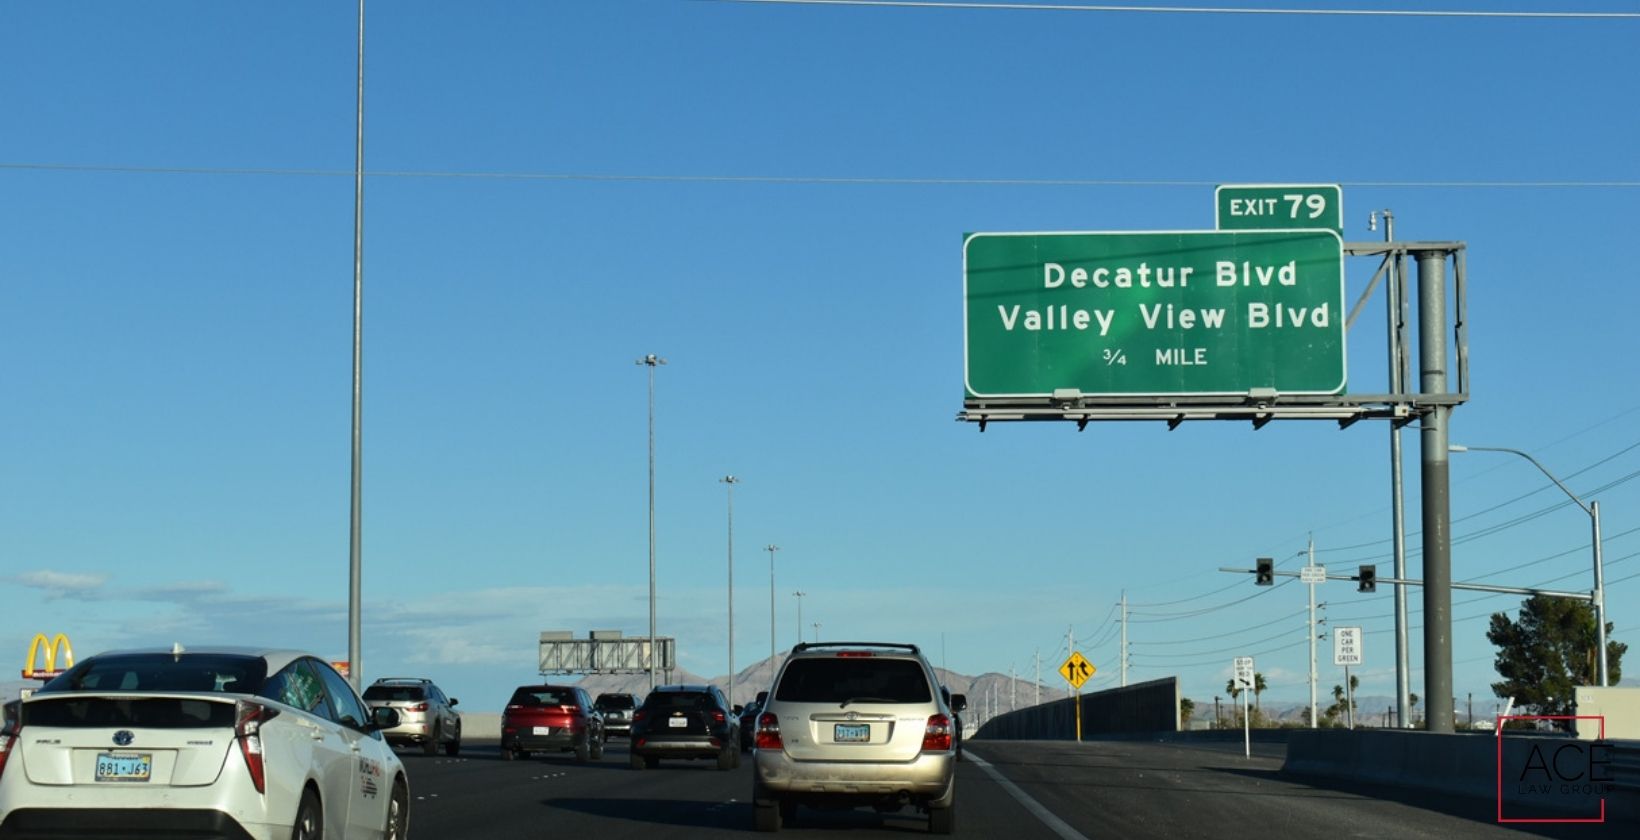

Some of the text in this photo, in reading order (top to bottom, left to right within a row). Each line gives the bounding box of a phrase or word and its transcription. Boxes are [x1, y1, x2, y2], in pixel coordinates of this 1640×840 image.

[1230, 194, 1326, 219] EXIT 79
[1044, 260, 1296, 288] Decatur Blvd
[998, 302, 1329, 336] Valley View Blvd
[1155, 348, 1208, 365] MILE
[1340, 638, 1353, 646] CAR
[1341, 646, 1353, 654] PER
[1337, 654, 1359, 662] GREEN
